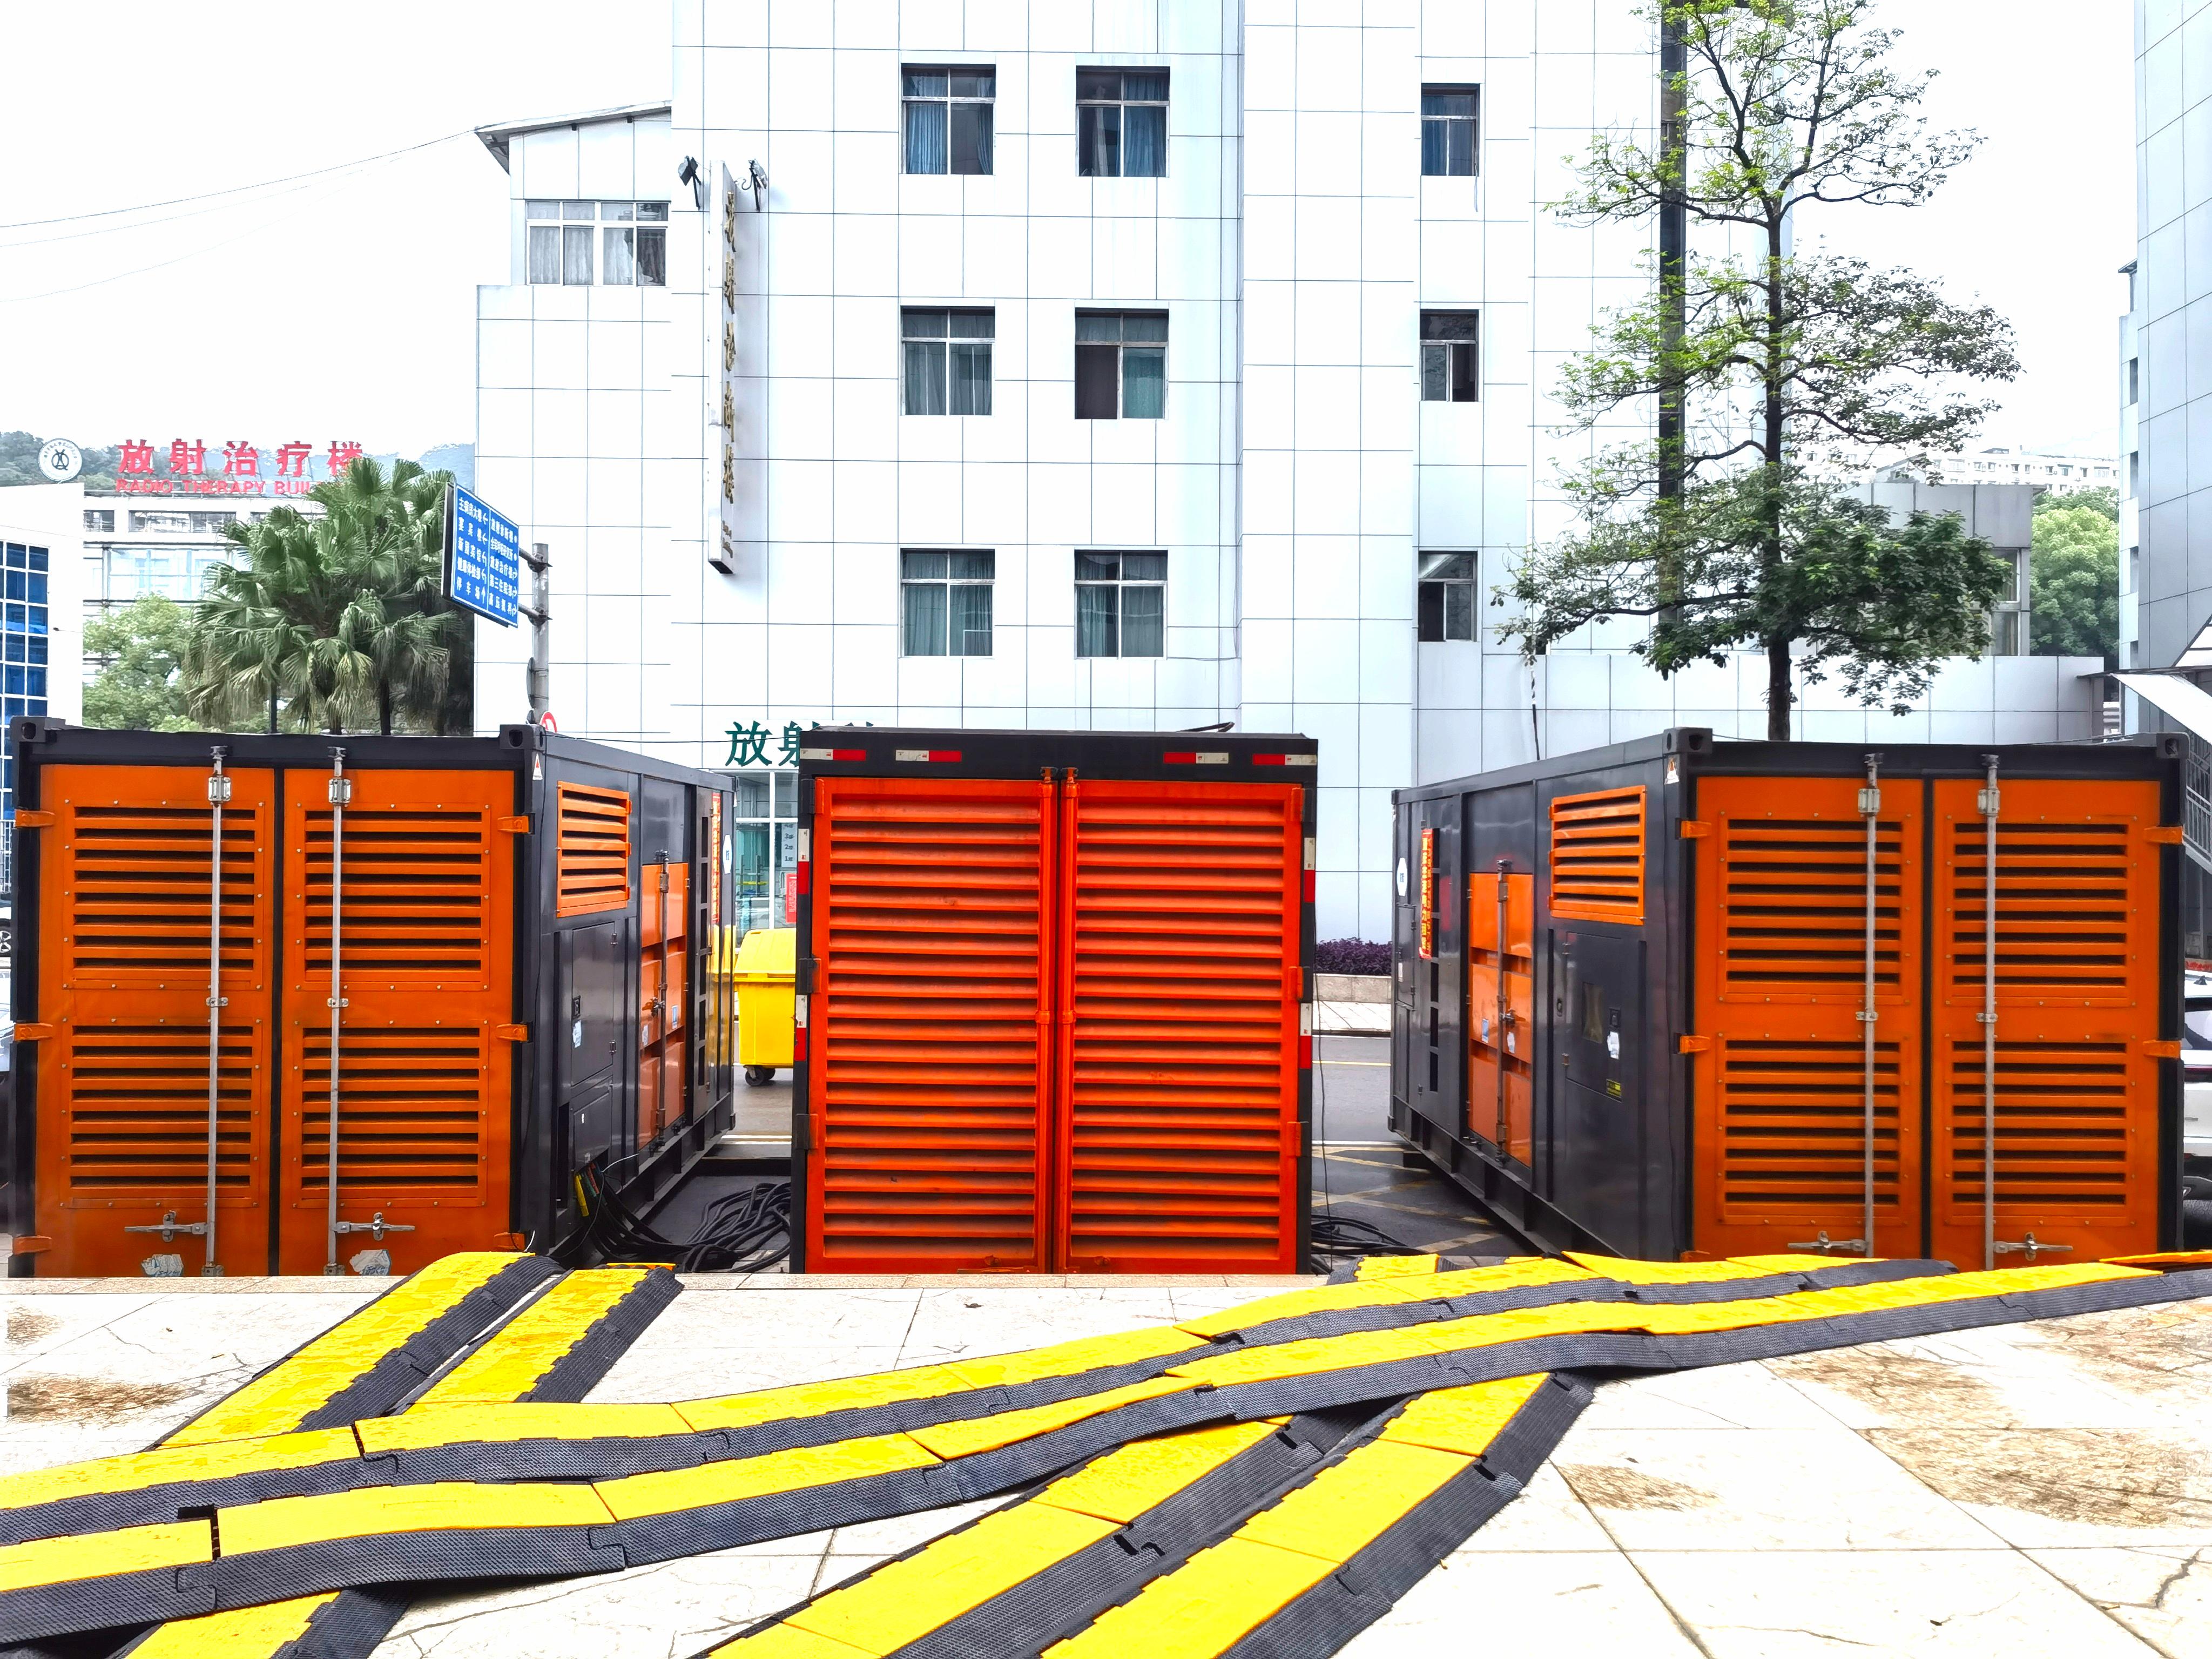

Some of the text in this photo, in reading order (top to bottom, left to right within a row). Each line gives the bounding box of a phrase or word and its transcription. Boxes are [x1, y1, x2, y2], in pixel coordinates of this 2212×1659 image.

[117, 439, 362, 477] 放射治疗楼
[116, 478, 173, 493] RADIO
[181, 480, 266, 494] THERAPY
